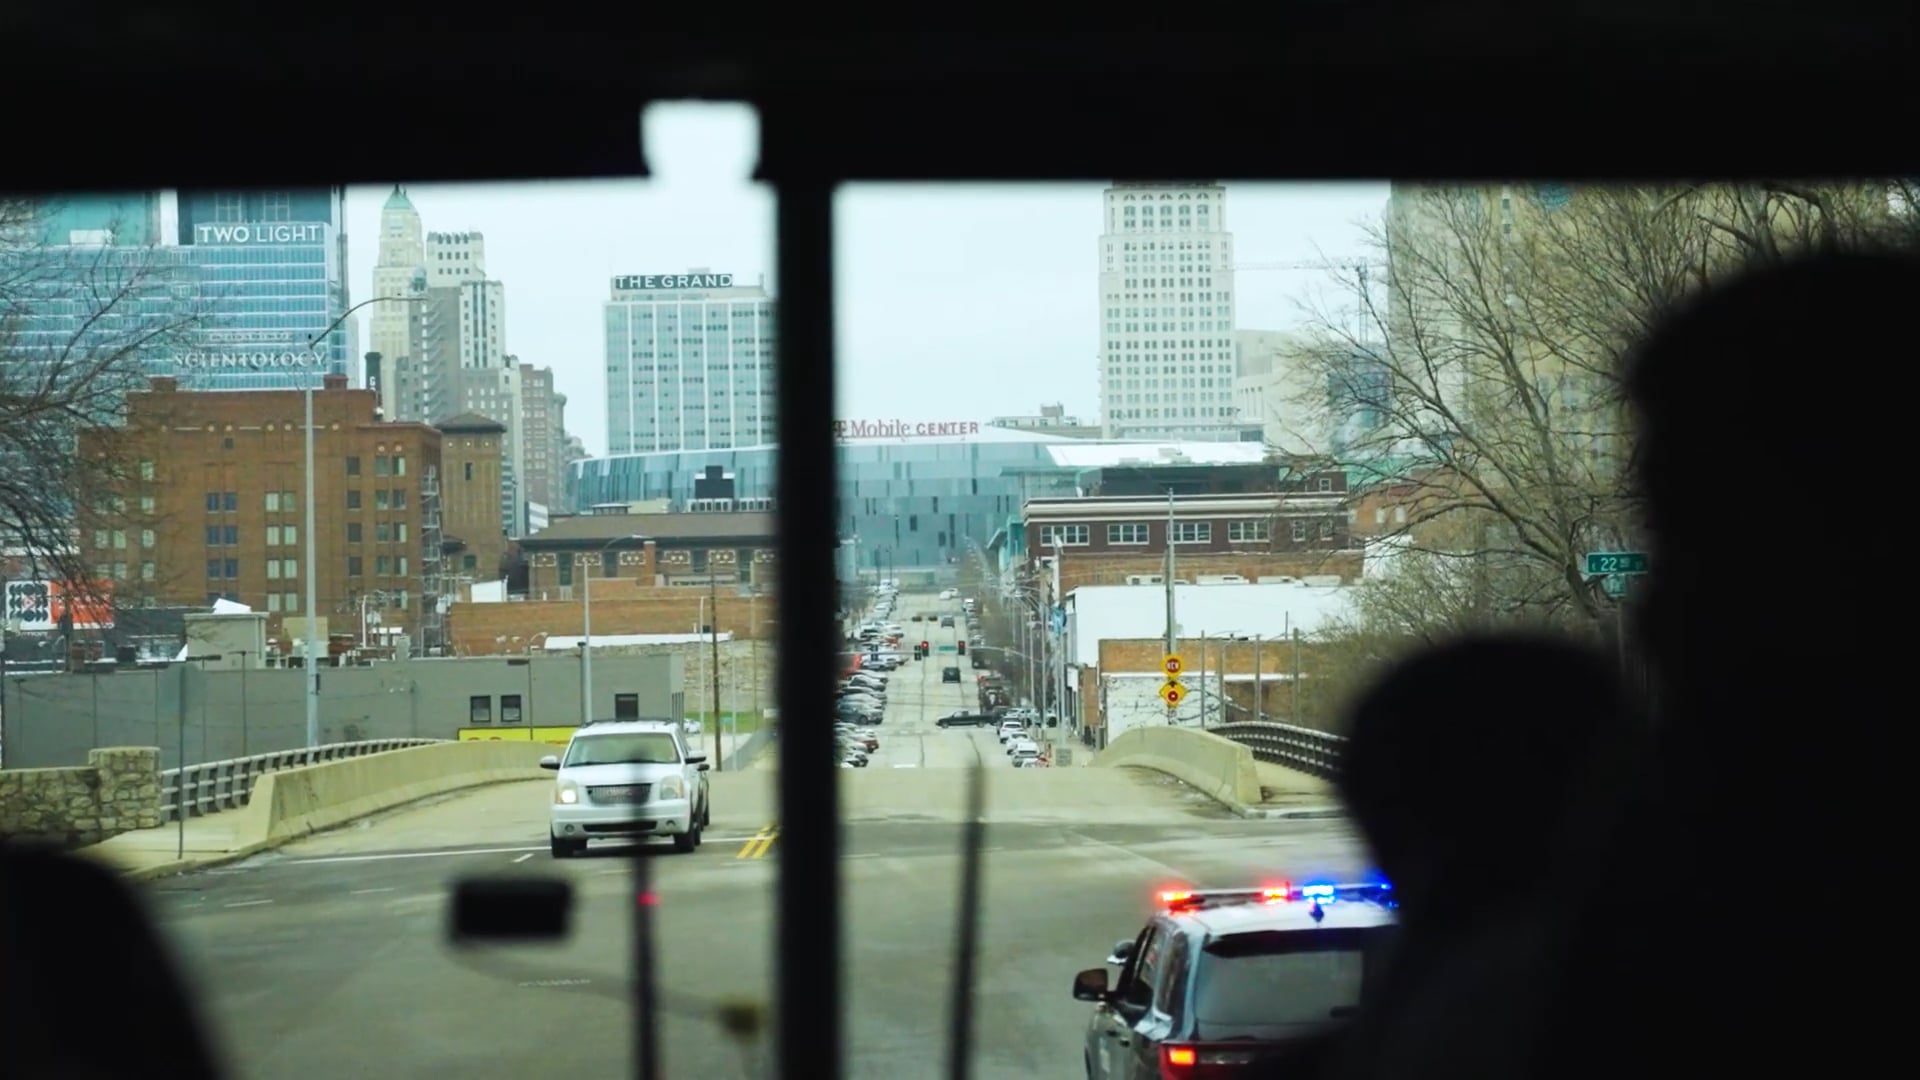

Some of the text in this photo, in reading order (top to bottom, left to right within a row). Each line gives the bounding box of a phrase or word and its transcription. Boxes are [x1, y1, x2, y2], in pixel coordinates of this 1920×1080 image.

[199, 224, 320, 243] TWO LIGHT
[615, 274, 733, 288] THE GRAND
[916, 421, 980, 436] CENTER
